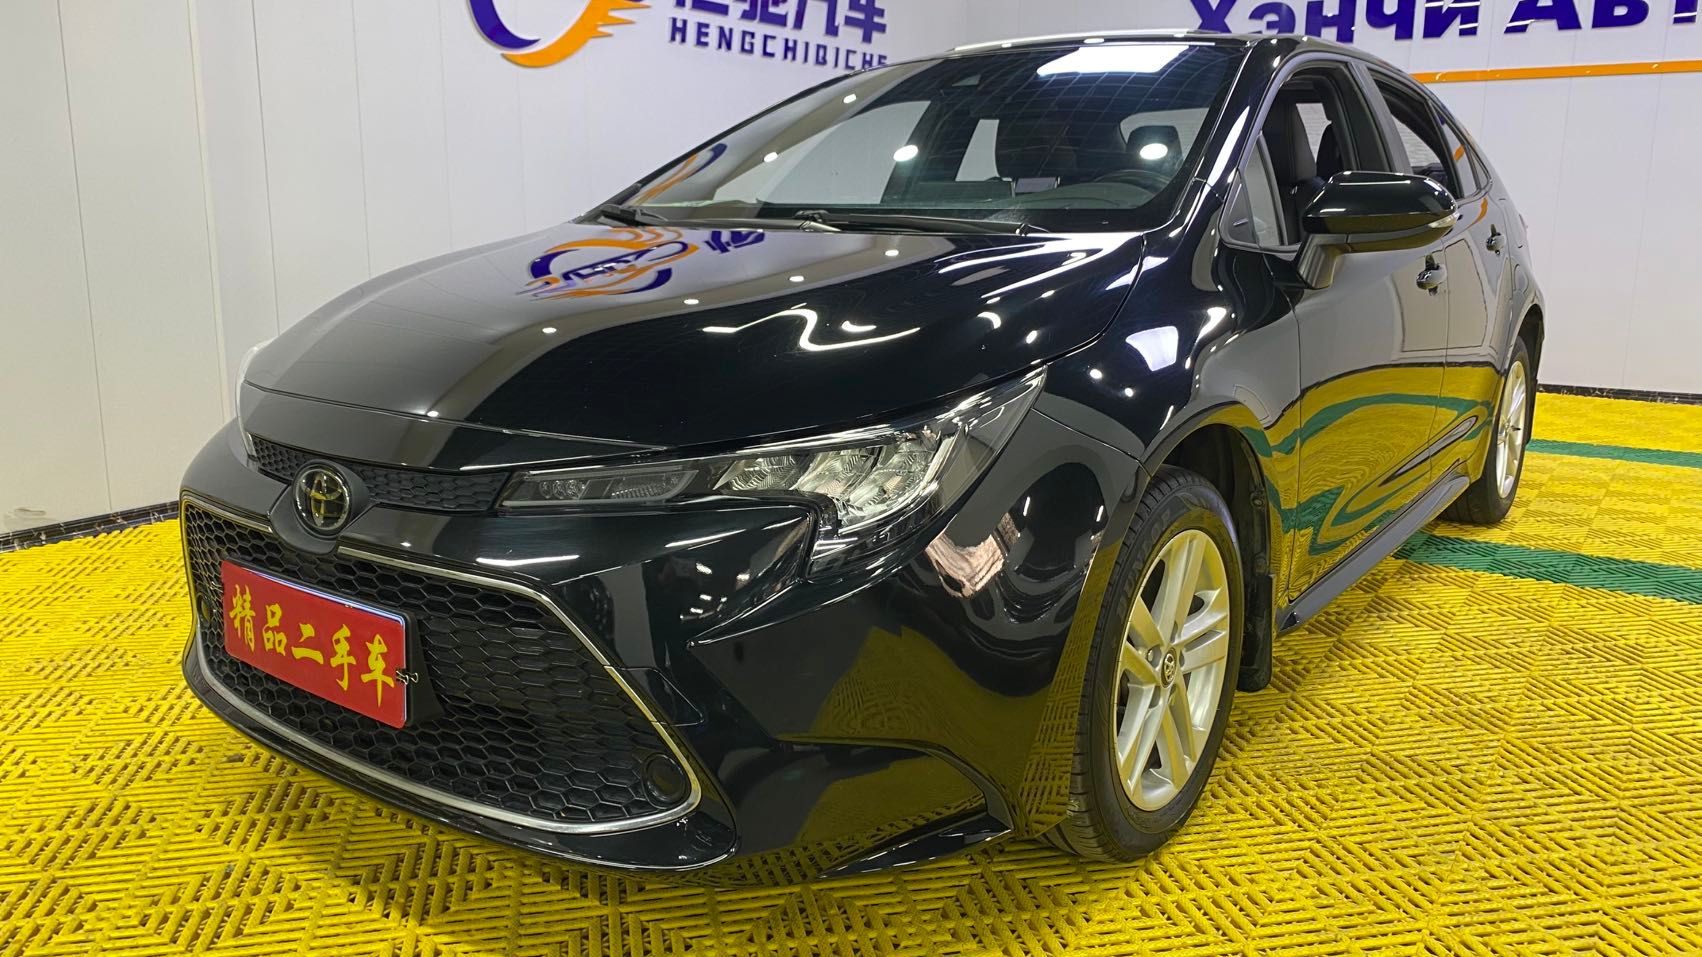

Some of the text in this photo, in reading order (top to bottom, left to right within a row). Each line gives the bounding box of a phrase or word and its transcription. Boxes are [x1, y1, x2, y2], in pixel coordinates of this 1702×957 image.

[229, 584, 395, 708] 精品二手车
